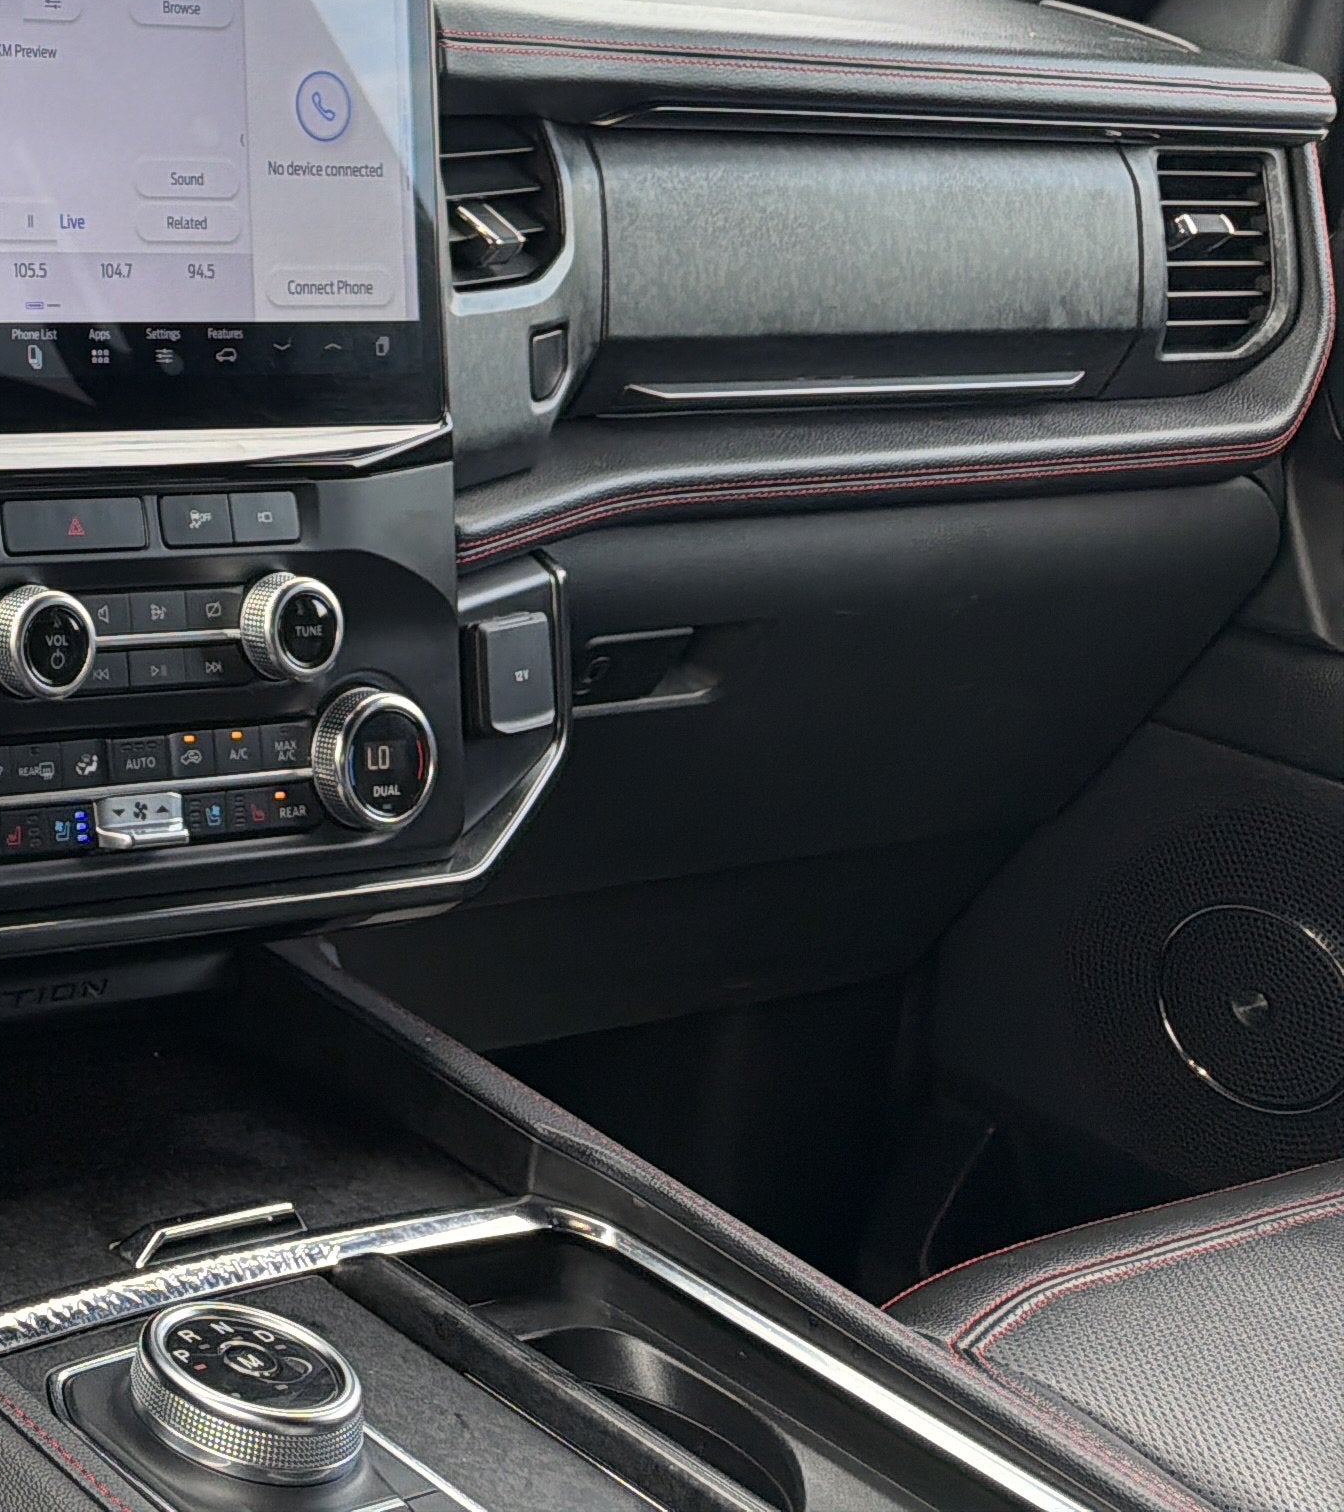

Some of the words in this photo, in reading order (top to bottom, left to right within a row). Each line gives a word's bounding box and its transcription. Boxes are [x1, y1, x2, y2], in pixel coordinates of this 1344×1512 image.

[162, 0, 200, 15] Browse
[14, 44, 57, 59] Preview
[268, 160, 285, 176] No
[286, 161, 323, 177] device
[324, 162, 384, 178] connected
[170, 172, 204, 187] Sound
[60, 214, 85, 230] Live
[167, 216, 207, 230] Related
[13, 262, 47, 278] 105.5
[100, 263, 132, 278] 104.7
[187, 263, 215, 279] 94.5
[287, 280, 335, 295] Connect
[337, 280, 374, 295] Phone
[12, 329, 40, 341] Phone
[41, 329, 57, 341] List
[89, 329, 110, 341] Apps
[145, 328, 181, 341] Settings
[207, 327, 243, 339] Features
[295, 625, 323, 637] TUNE
[46, 634, 69, 647] VOL
[514, 669, 530, 682] 12V
[274, 741, 297, 751] MAX
[229, 747, 248, 760] A/C
[278, 750, 296, 762] A/C
[367, 746, 390, 771] LO
[125, 757, 156, 771] AUTO
[18, 766, 40, 777] REAR
[373, 785, 401, 797] DUAL
[279, 805, 307, 818] REAR
[210, 1322, 234, 1334] N
[177, 1329, 202, 1343] R
[253, 1330, 274, 1342] D
[172, 1349, 191, 1364] P
[237, 1353, 264, 1369] M
